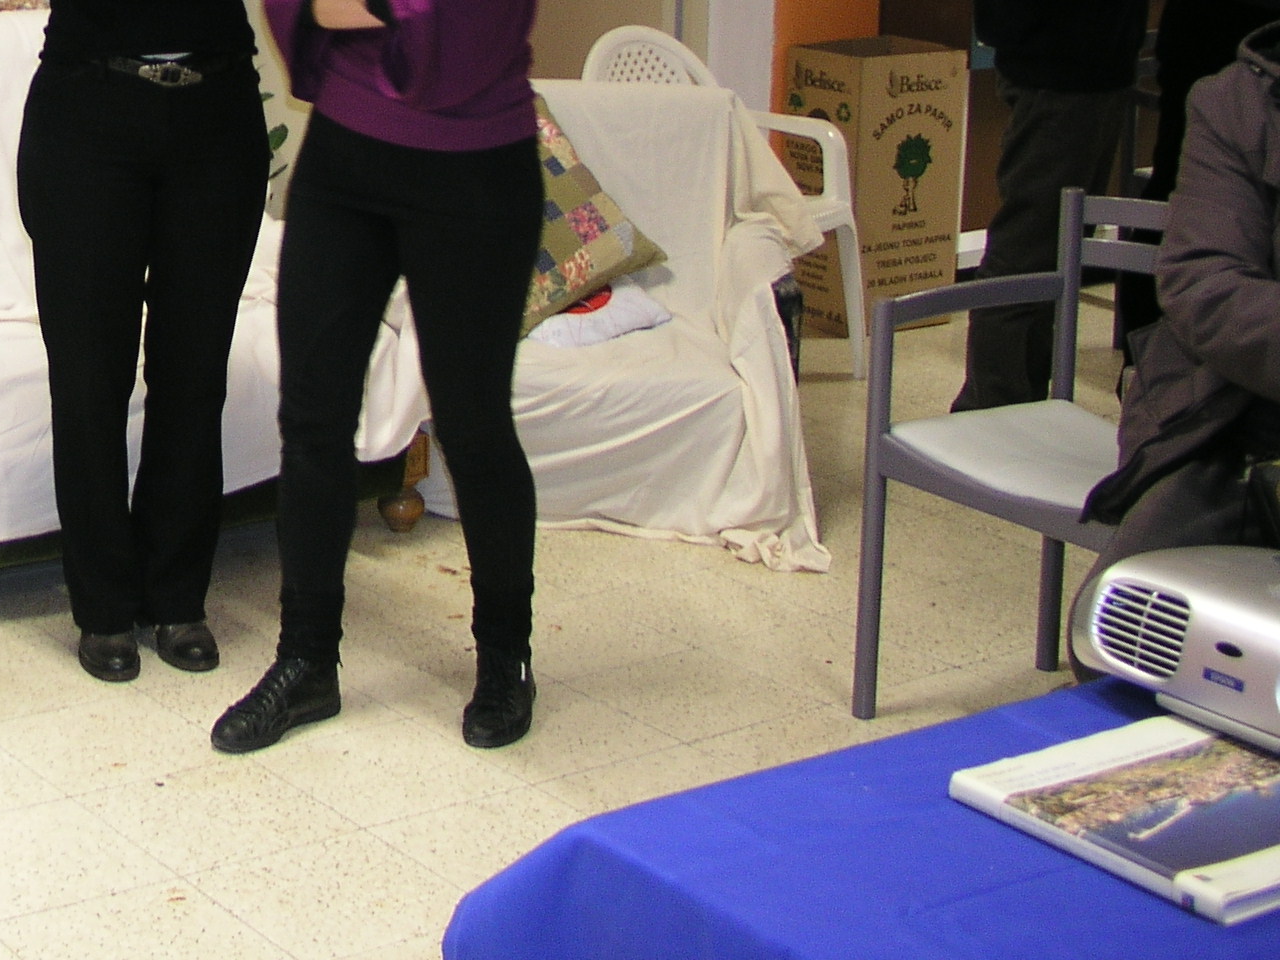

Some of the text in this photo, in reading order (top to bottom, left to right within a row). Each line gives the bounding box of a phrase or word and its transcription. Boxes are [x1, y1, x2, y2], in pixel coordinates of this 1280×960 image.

[872, 103, 953, 141] SAMO ZA PAPIR
[924, 233, 951, 244] PAPIRA
[876, 257, 903, 269] TREBA
[909, 269, 943, 281] STABALA
